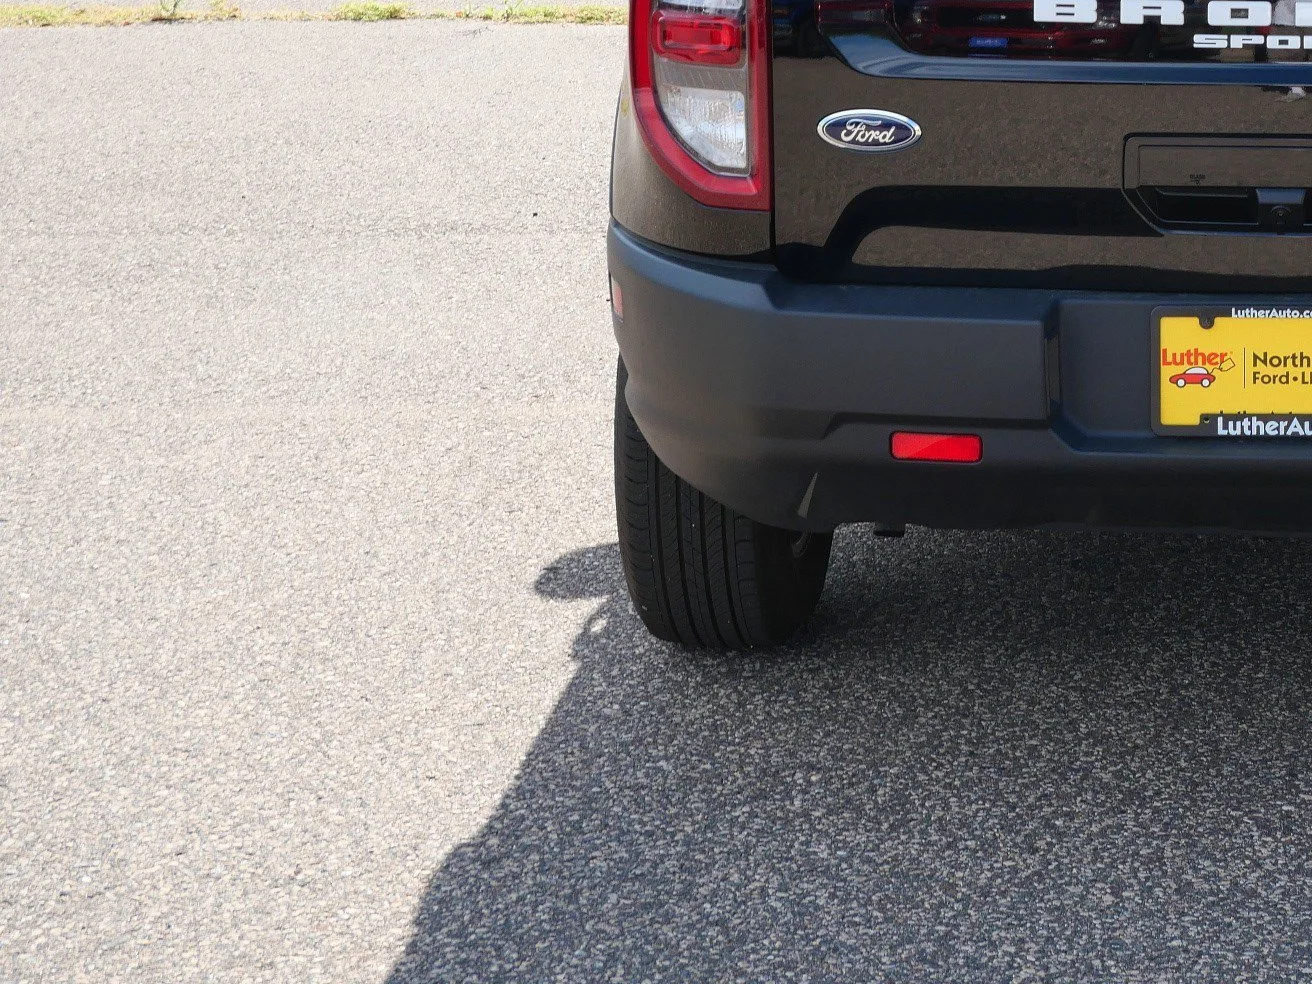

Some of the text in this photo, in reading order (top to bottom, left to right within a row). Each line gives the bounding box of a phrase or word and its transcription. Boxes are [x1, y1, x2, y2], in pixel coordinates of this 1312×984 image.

[841, 118, 896, 143] Ford
[1161, 347, 1228, 367] Luther
[1252, 351, 1311, 368] North
